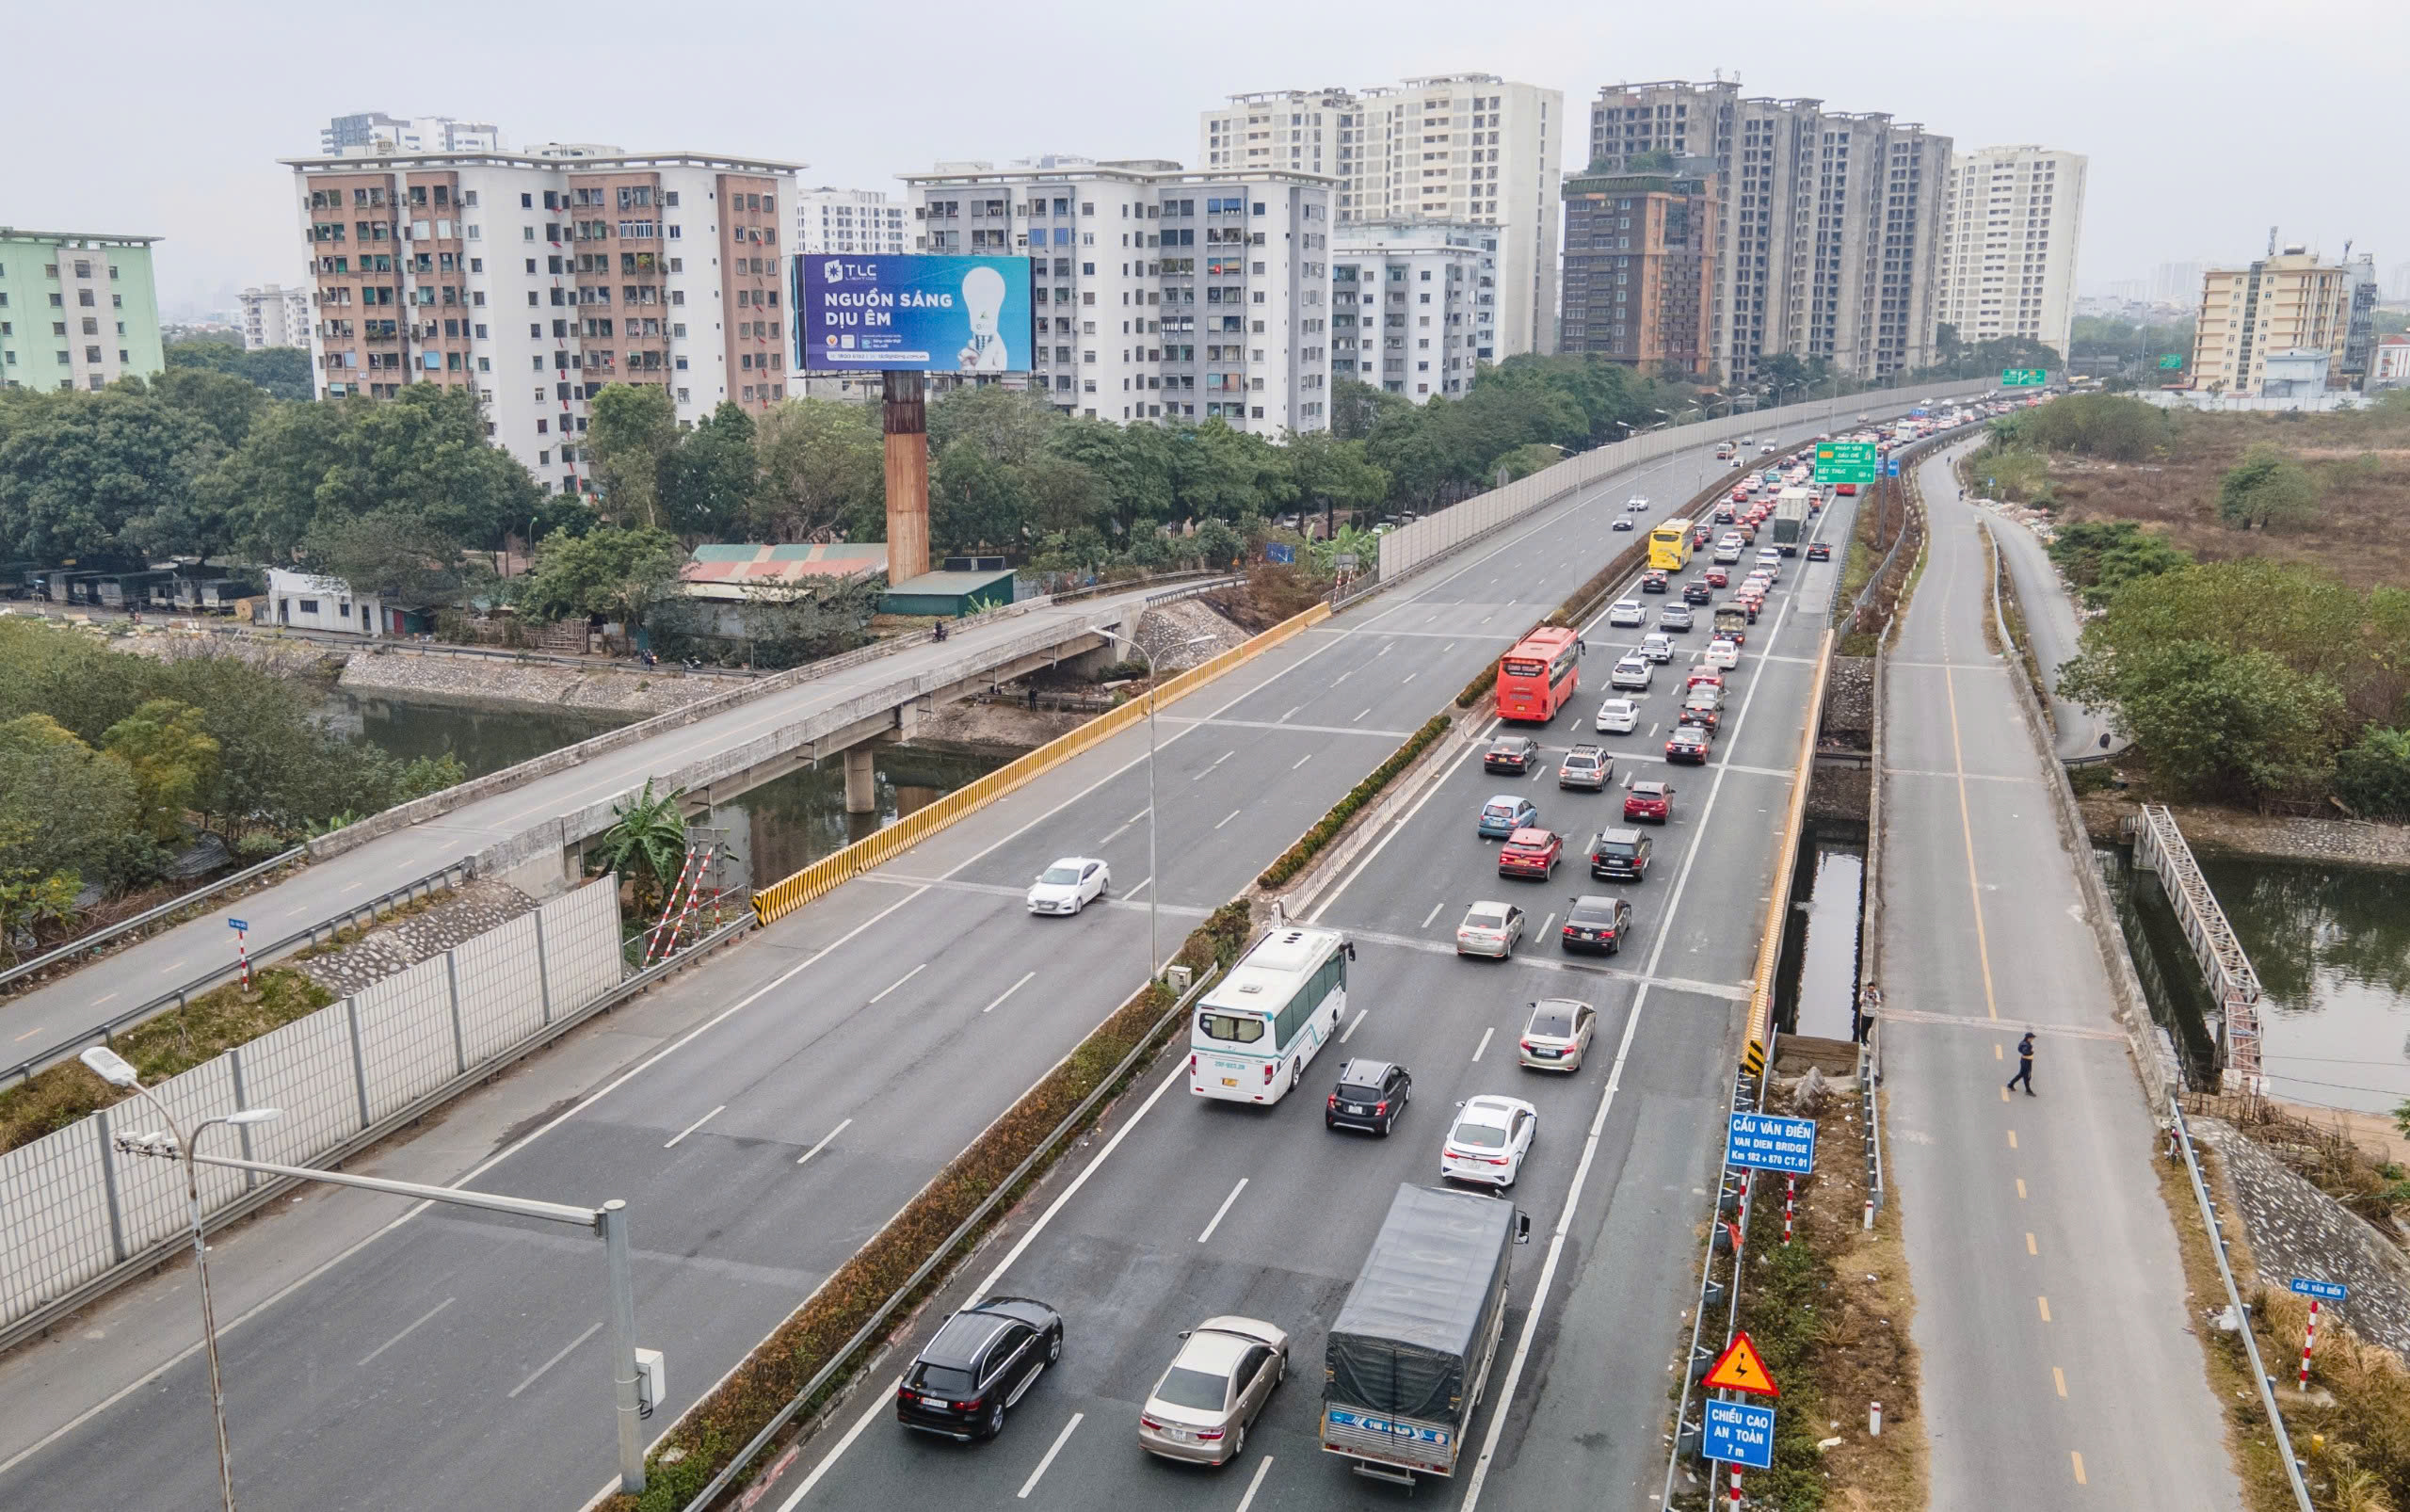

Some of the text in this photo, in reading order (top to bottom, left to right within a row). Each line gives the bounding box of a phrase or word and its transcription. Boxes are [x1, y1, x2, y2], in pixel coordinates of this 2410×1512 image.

[845, 264, 876, 277] TLC
[825, 288, 953, 308] NGUỒN SÁNG
[825, 310, 891, 330] DỊU ÊM
[1732, 1116, 1756, 1133] CẦU
[1760, 1120, 1782, 1135] VĂN
[1734, 1136, 1808, 1153] VAN DIEN BRIDGE
[1732, 1150, 1744, 1160] Km
[1769, 1154, 1782, 1164] 870
[1784, 1156, 1808, 1167] CT.01
[1711, 1407, 1768, 1428] CHIỀU CAO
[1714, 1425, 1763, 1444] AN TOÀN
[1727, 1444, 1744, 1456] 7 m
